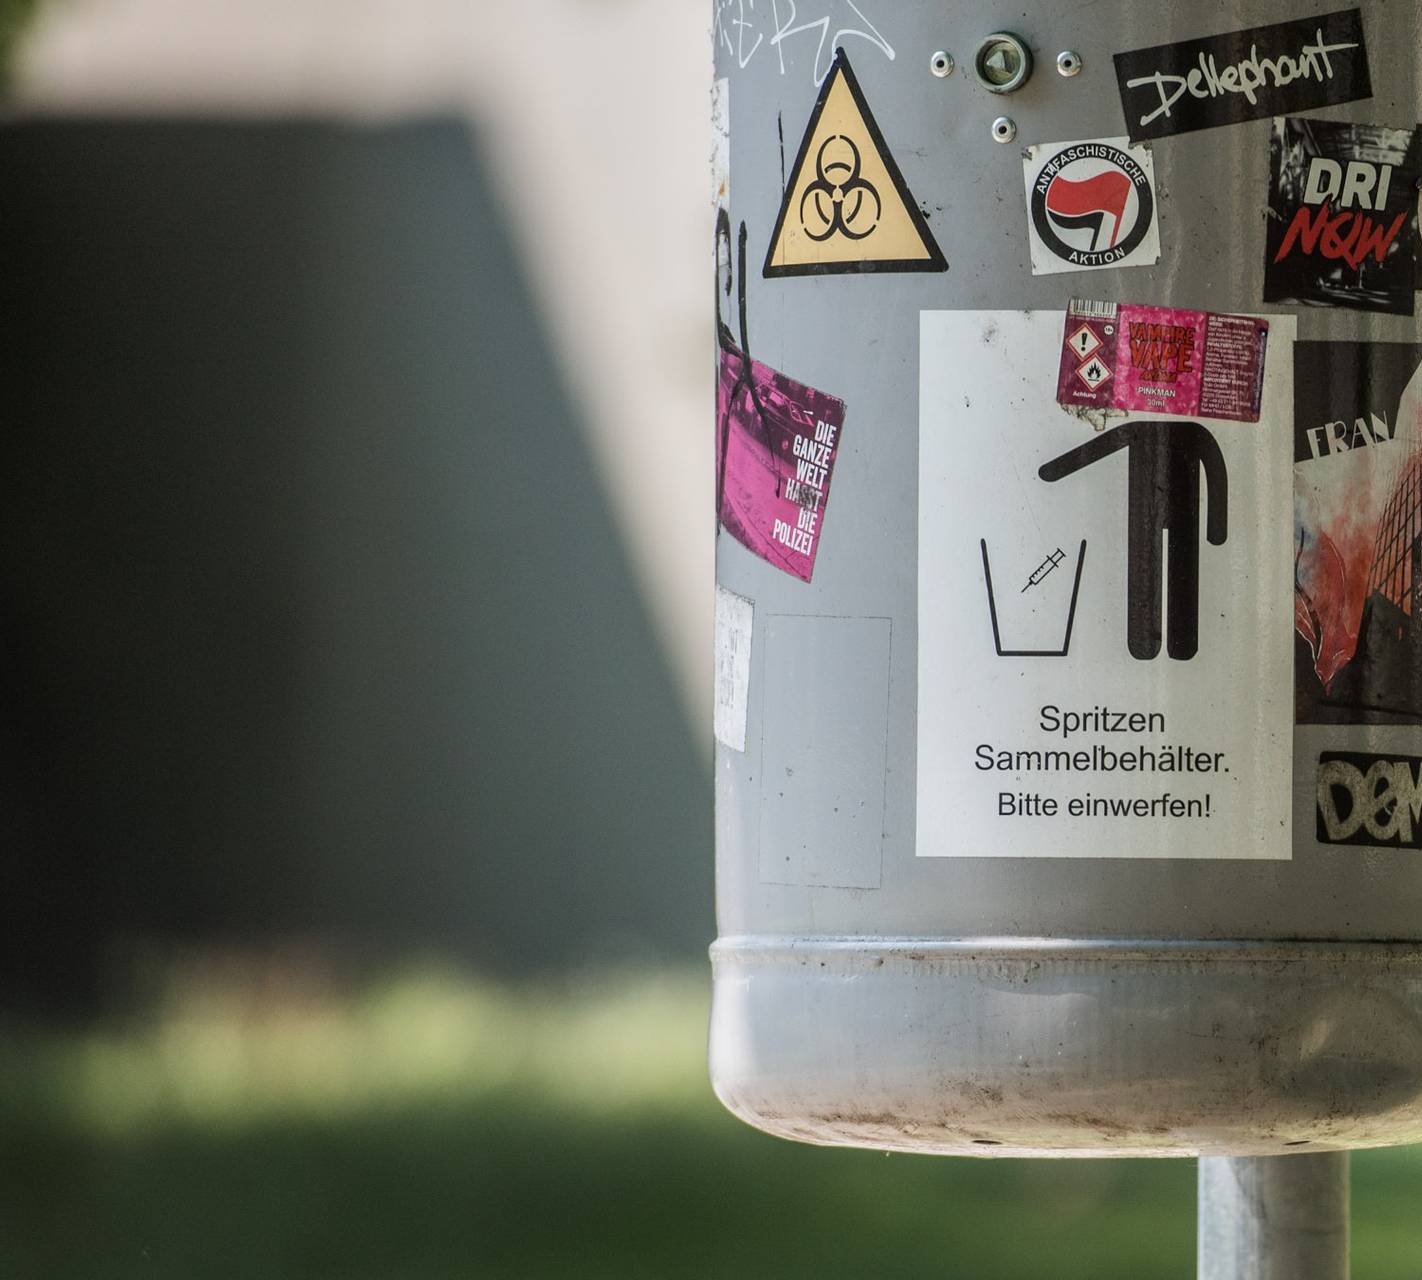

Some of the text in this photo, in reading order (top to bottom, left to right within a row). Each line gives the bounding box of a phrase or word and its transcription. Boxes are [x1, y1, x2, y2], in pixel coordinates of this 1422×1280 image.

[1303, 157, 1393, 212] DRI
[1068, 247, 1126, 265] AKTION
[1129, 338, 1194, 373] VAPE
[1072, 390, 1097, 400] Achtung
[1137, 386, 1177, 398] PINKMAN
[814, 420, 837, 447] DIE
[792, 434, 832, 468] GANZE
[796, 458, 828, 490] WELT
[785, 477, 823, 512] HASST
[797, 508, 818, 535] DIE
[772, 518, 814, 556] POLIZEI
[1039, 704, 1166, 739] Spritzen
[974, 744, 1230, 773] Sammelbehälter.
[998, 792, 1211, 818] Bitte einwerfen!
